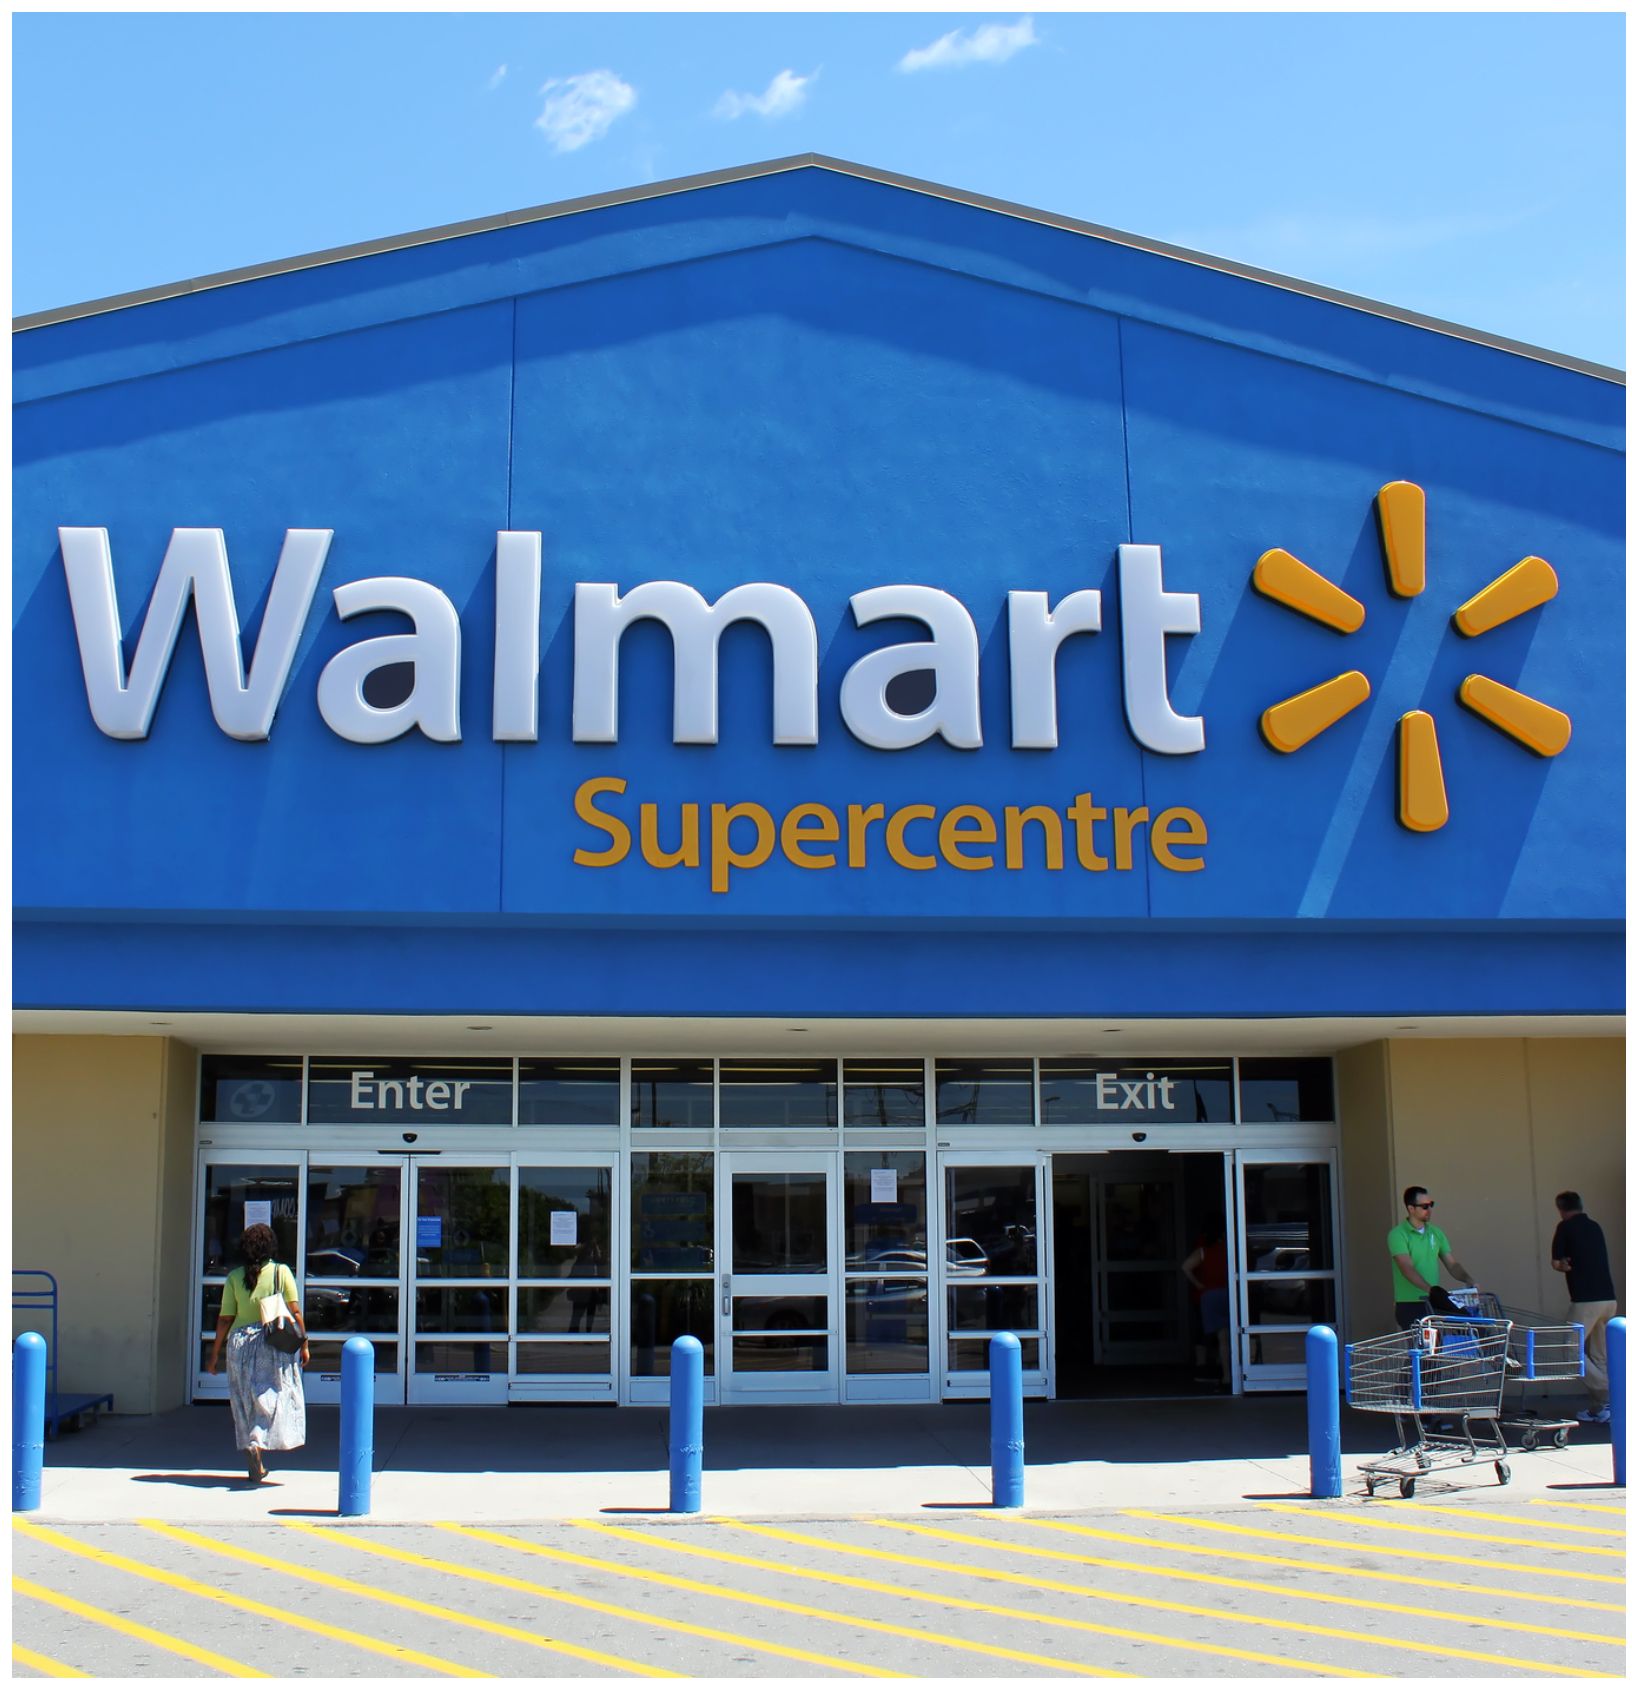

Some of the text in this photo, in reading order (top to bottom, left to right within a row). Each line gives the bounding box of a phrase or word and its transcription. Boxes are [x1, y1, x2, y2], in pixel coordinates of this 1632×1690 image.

[58, 526, 1206, 755] Walmart
[573, 776, 1208, 893] Supercentre
[350, 1071, 470, 1110] Enter
[1096, 1073, 1175, 1110] Exit
